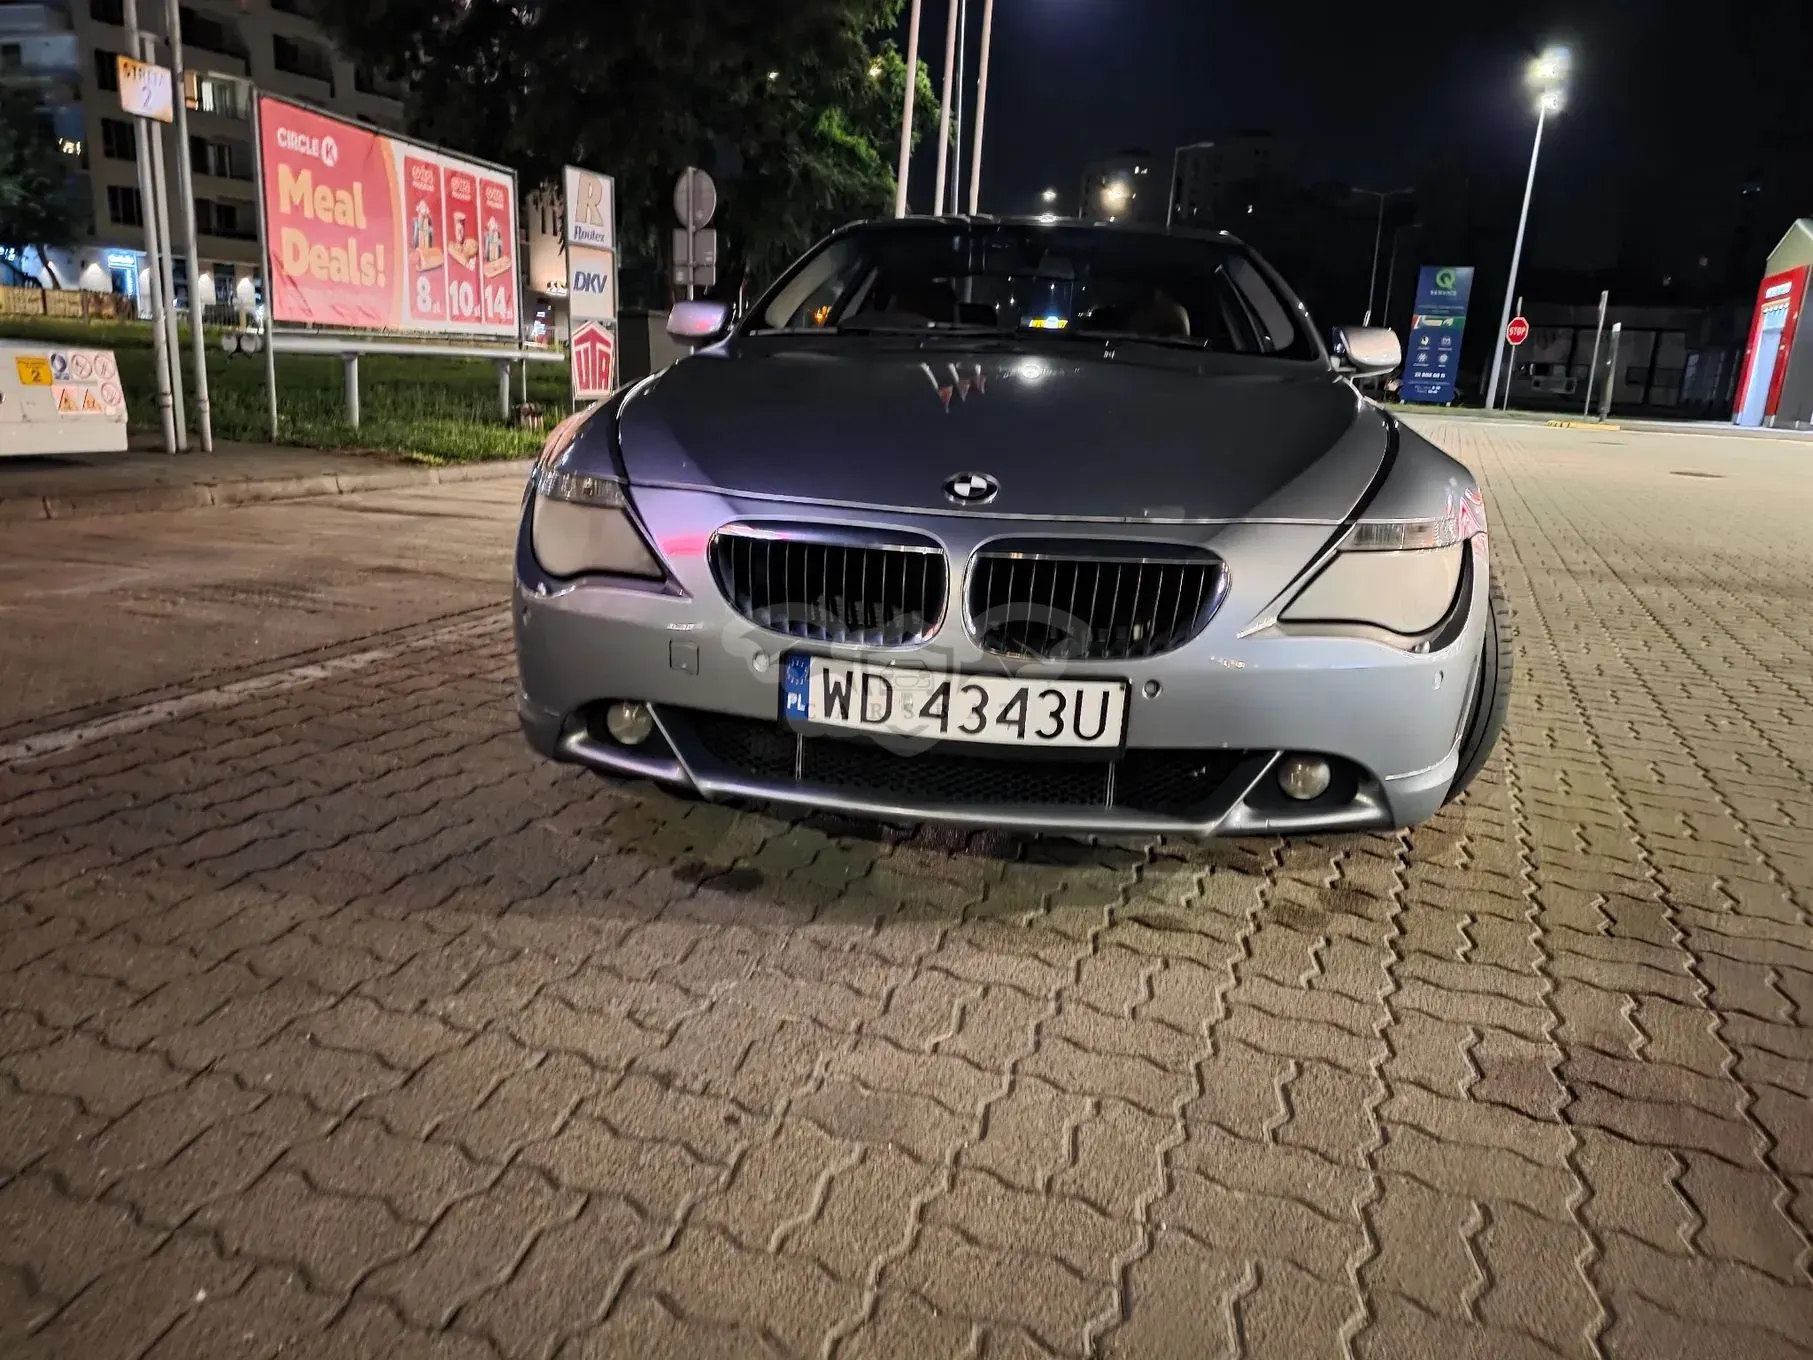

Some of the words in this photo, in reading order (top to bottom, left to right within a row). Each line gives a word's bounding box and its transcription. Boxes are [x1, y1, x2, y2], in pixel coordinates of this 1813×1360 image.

[142, 86, 153, 109] 2
[277, 127, 320, 157] CIRCLE
[277, 164, 367, 229] Meal
[576, 171, 604, 227] R
[281, 227, 386, 288] Deals!
[417, 276, 431, 312] 8
[449, 280, 473, 317] 10
[573, 271, 607, 293] DKV
[485, 284, 506, 319] 14
[1509, 326, 1525, 336] STOP
[32, 369, 41, 381] 2
[787, 692, 805, 711] PL
[822, 667, 892, 725] WD
[918, 680, 1110, 741] 4343U
